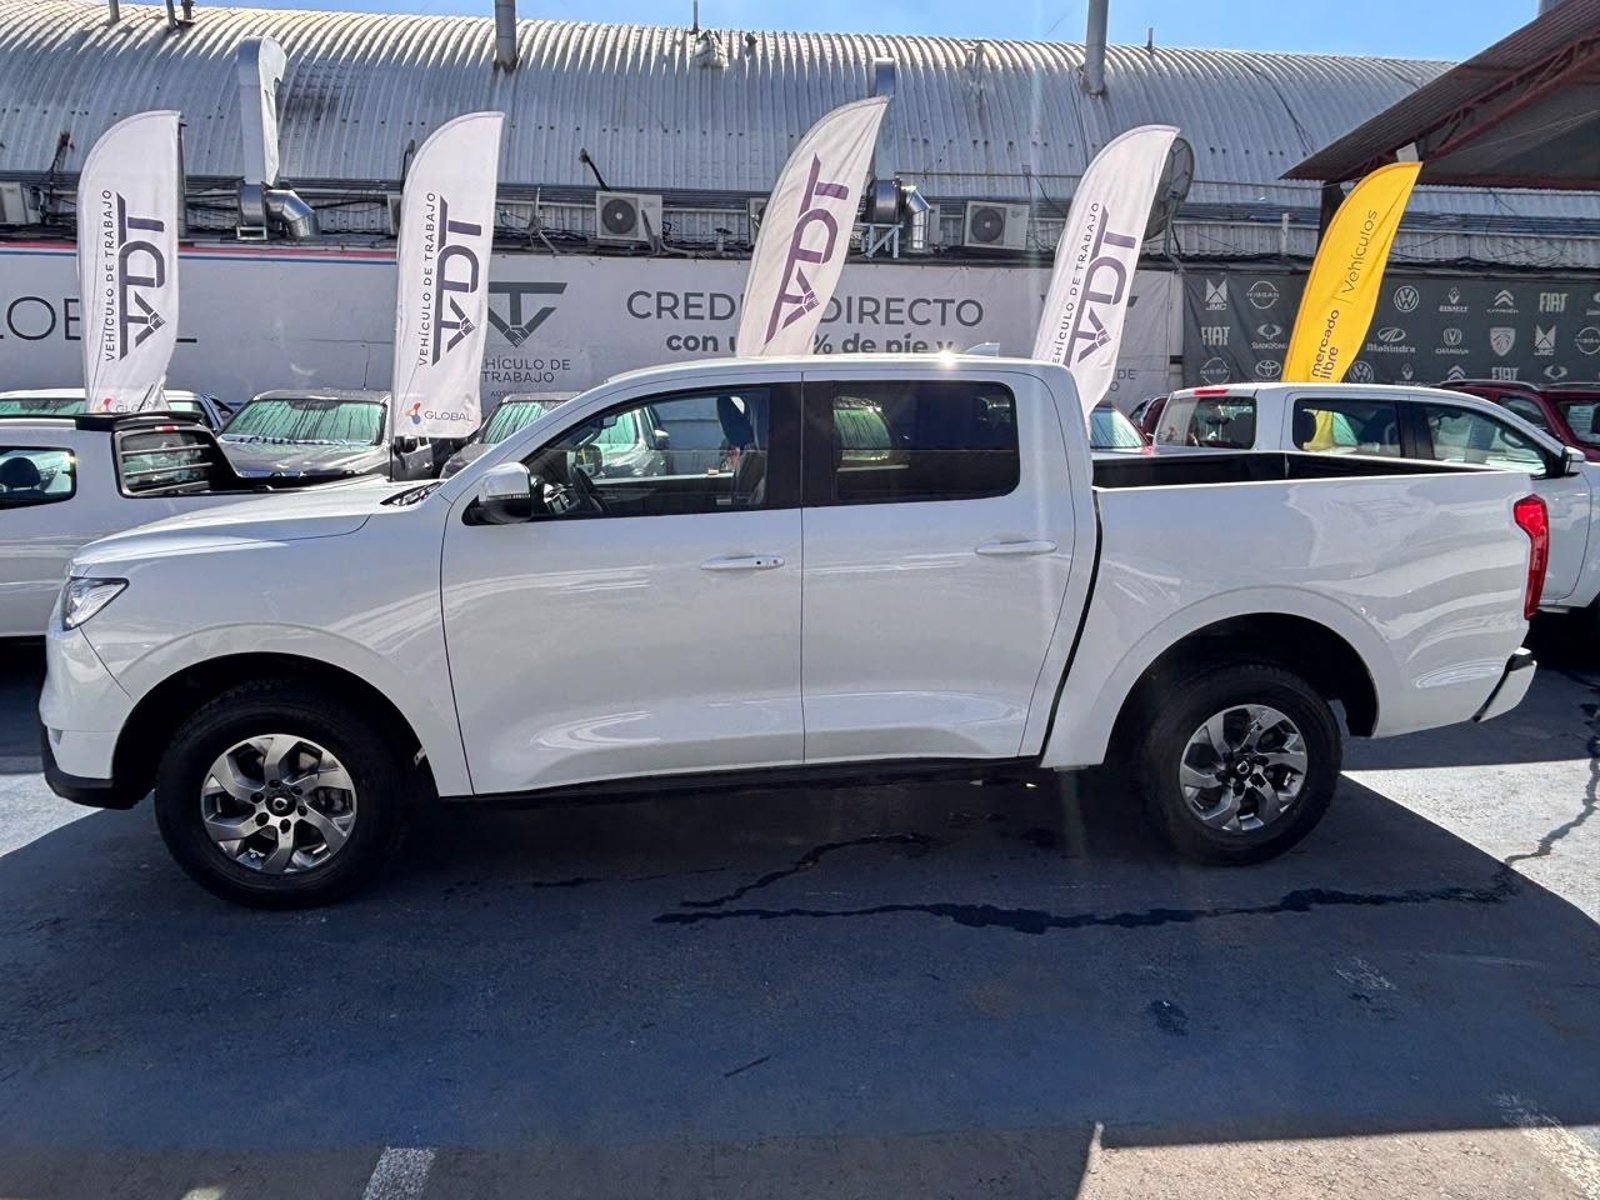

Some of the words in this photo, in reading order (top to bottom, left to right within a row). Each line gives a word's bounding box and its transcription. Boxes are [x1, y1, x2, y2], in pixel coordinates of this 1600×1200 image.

[102, 190, 114, 259] TRABAJO
[424, 192, 436, 261] TRABAJO
[1075, 202, 1100, 271] TRABAJO
[1342, 209, 1378, 294] Vehículos
[106, 265, 115, 282] DE
[423, 267, 432, 286] DE
[1070, 278, 1081, 296] DE
[627, 290, 744, 320] CRED
[820, 295, 984, 327] DIRECTO
[1205, 302, 1228, 311] JMC
[1539, 292, 1569, 313] FIAT
[419, 293, 431, 366] VEHÍCULO
[1052, 302, 1075, 364] EHÍCULO
[1200, 326, 1231, 347] FIAT
[666, 335, 719, 352] con
[842, 333, 877, 353] de
[1311, 309, 1340, 377] mercado
[1366, 342, 1416, 354] Mahindra
[485, 355, 545, 370] HÍCULO
[550, 359, 571, 371] DE
[1319, 346, 1339, 379] libre
[480, 371, 555, 383] TRABAJO
[1117, 369, 1137, 380] DE
[1491, 367, 1520, 380] FIAT
[424, 410, 473, 422] GLOBAL
